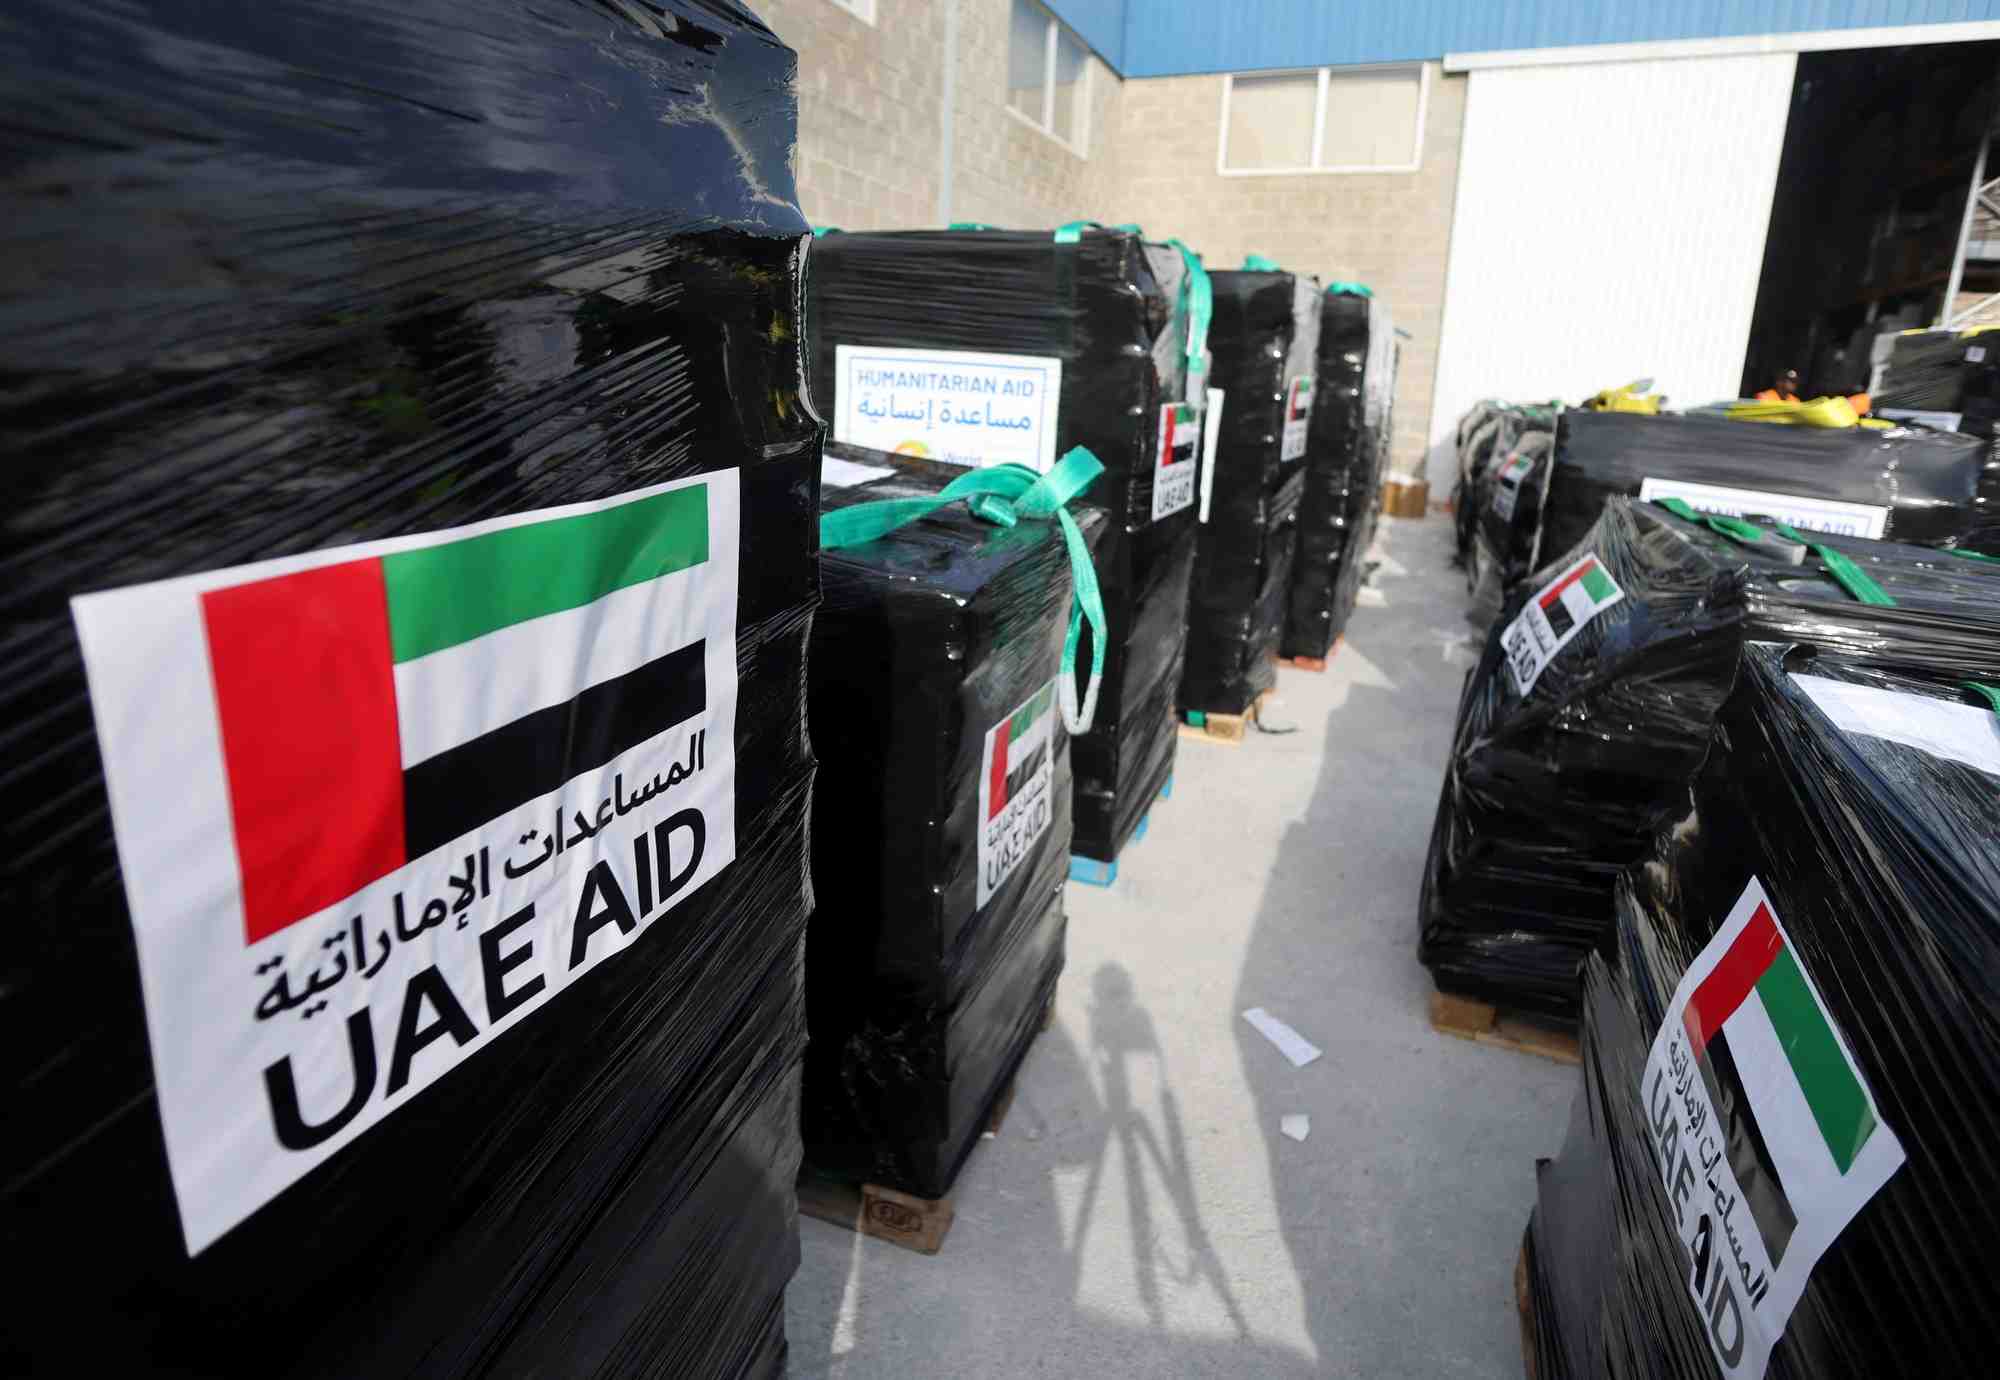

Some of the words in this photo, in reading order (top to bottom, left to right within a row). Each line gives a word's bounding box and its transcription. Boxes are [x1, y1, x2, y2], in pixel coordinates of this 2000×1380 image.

[857, 369, 996, 393] HUMANITARIAN
[1001, 379, 1035, 397] AID
[857, 391, 934, 431] إنسانية
[939, 399, 1033, 431] مساعدة
[501, 727, 706, 880] المساعدات
[987, 832, 1020, 891] UAE
[1023, 797, 1046, 840] AID
[253, 846, 490, 1022] الإماراتية
[263, 902, 547, 1152] UAE
[568, 807, 707, 973] AID
[1651, 1068, 1696, 1228] UAE
[1690, 1212, 1745, 1369] AID
[1700, 1136, 1770, 1312] المساعدات
